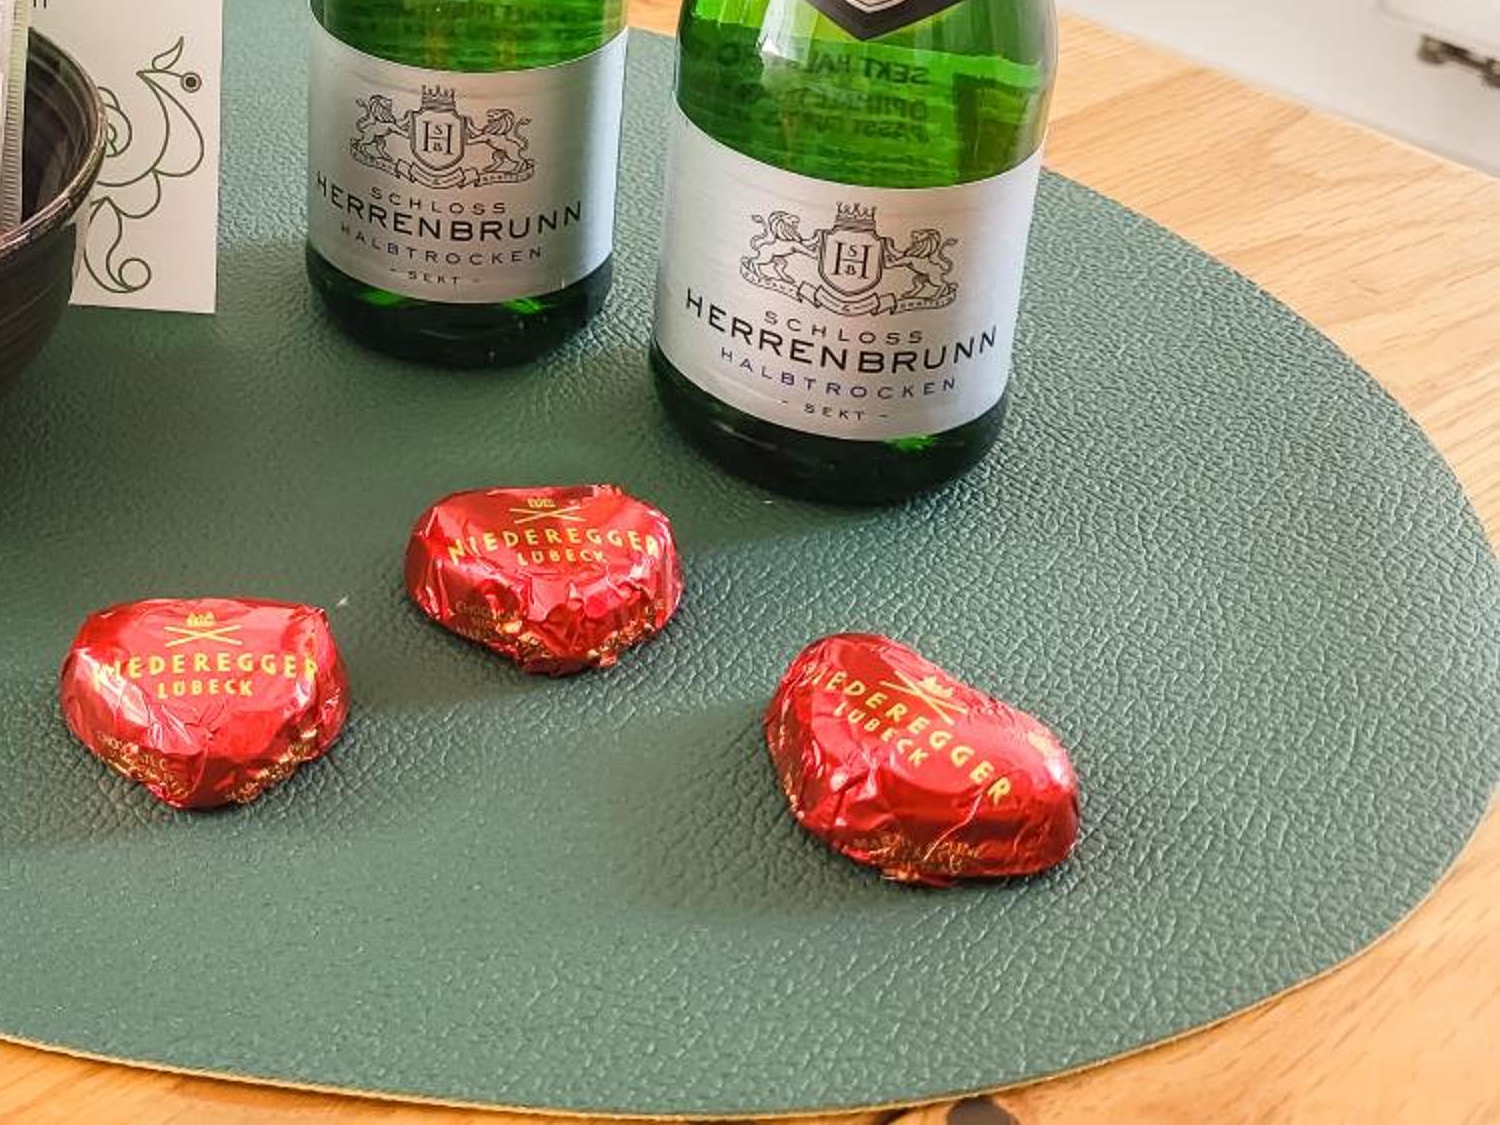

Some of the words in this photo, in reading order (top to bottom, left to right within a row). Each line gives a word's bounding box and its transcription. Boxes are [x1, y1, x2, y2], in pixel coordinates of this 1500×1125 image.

[316, 171, 583, 243] HERRENBRUNN
[370, 186, 507, 215] SCHLOSS
[341, 224, 542, 266] HALBTROCKEN
[685, 286, 998, 374] HERRENBRUNN
[763, 309, 925, 345] SCHLOSS
[720, 346, 957, 399] HALBTROCKEN
[803, 403, 867, 421] SEKT
